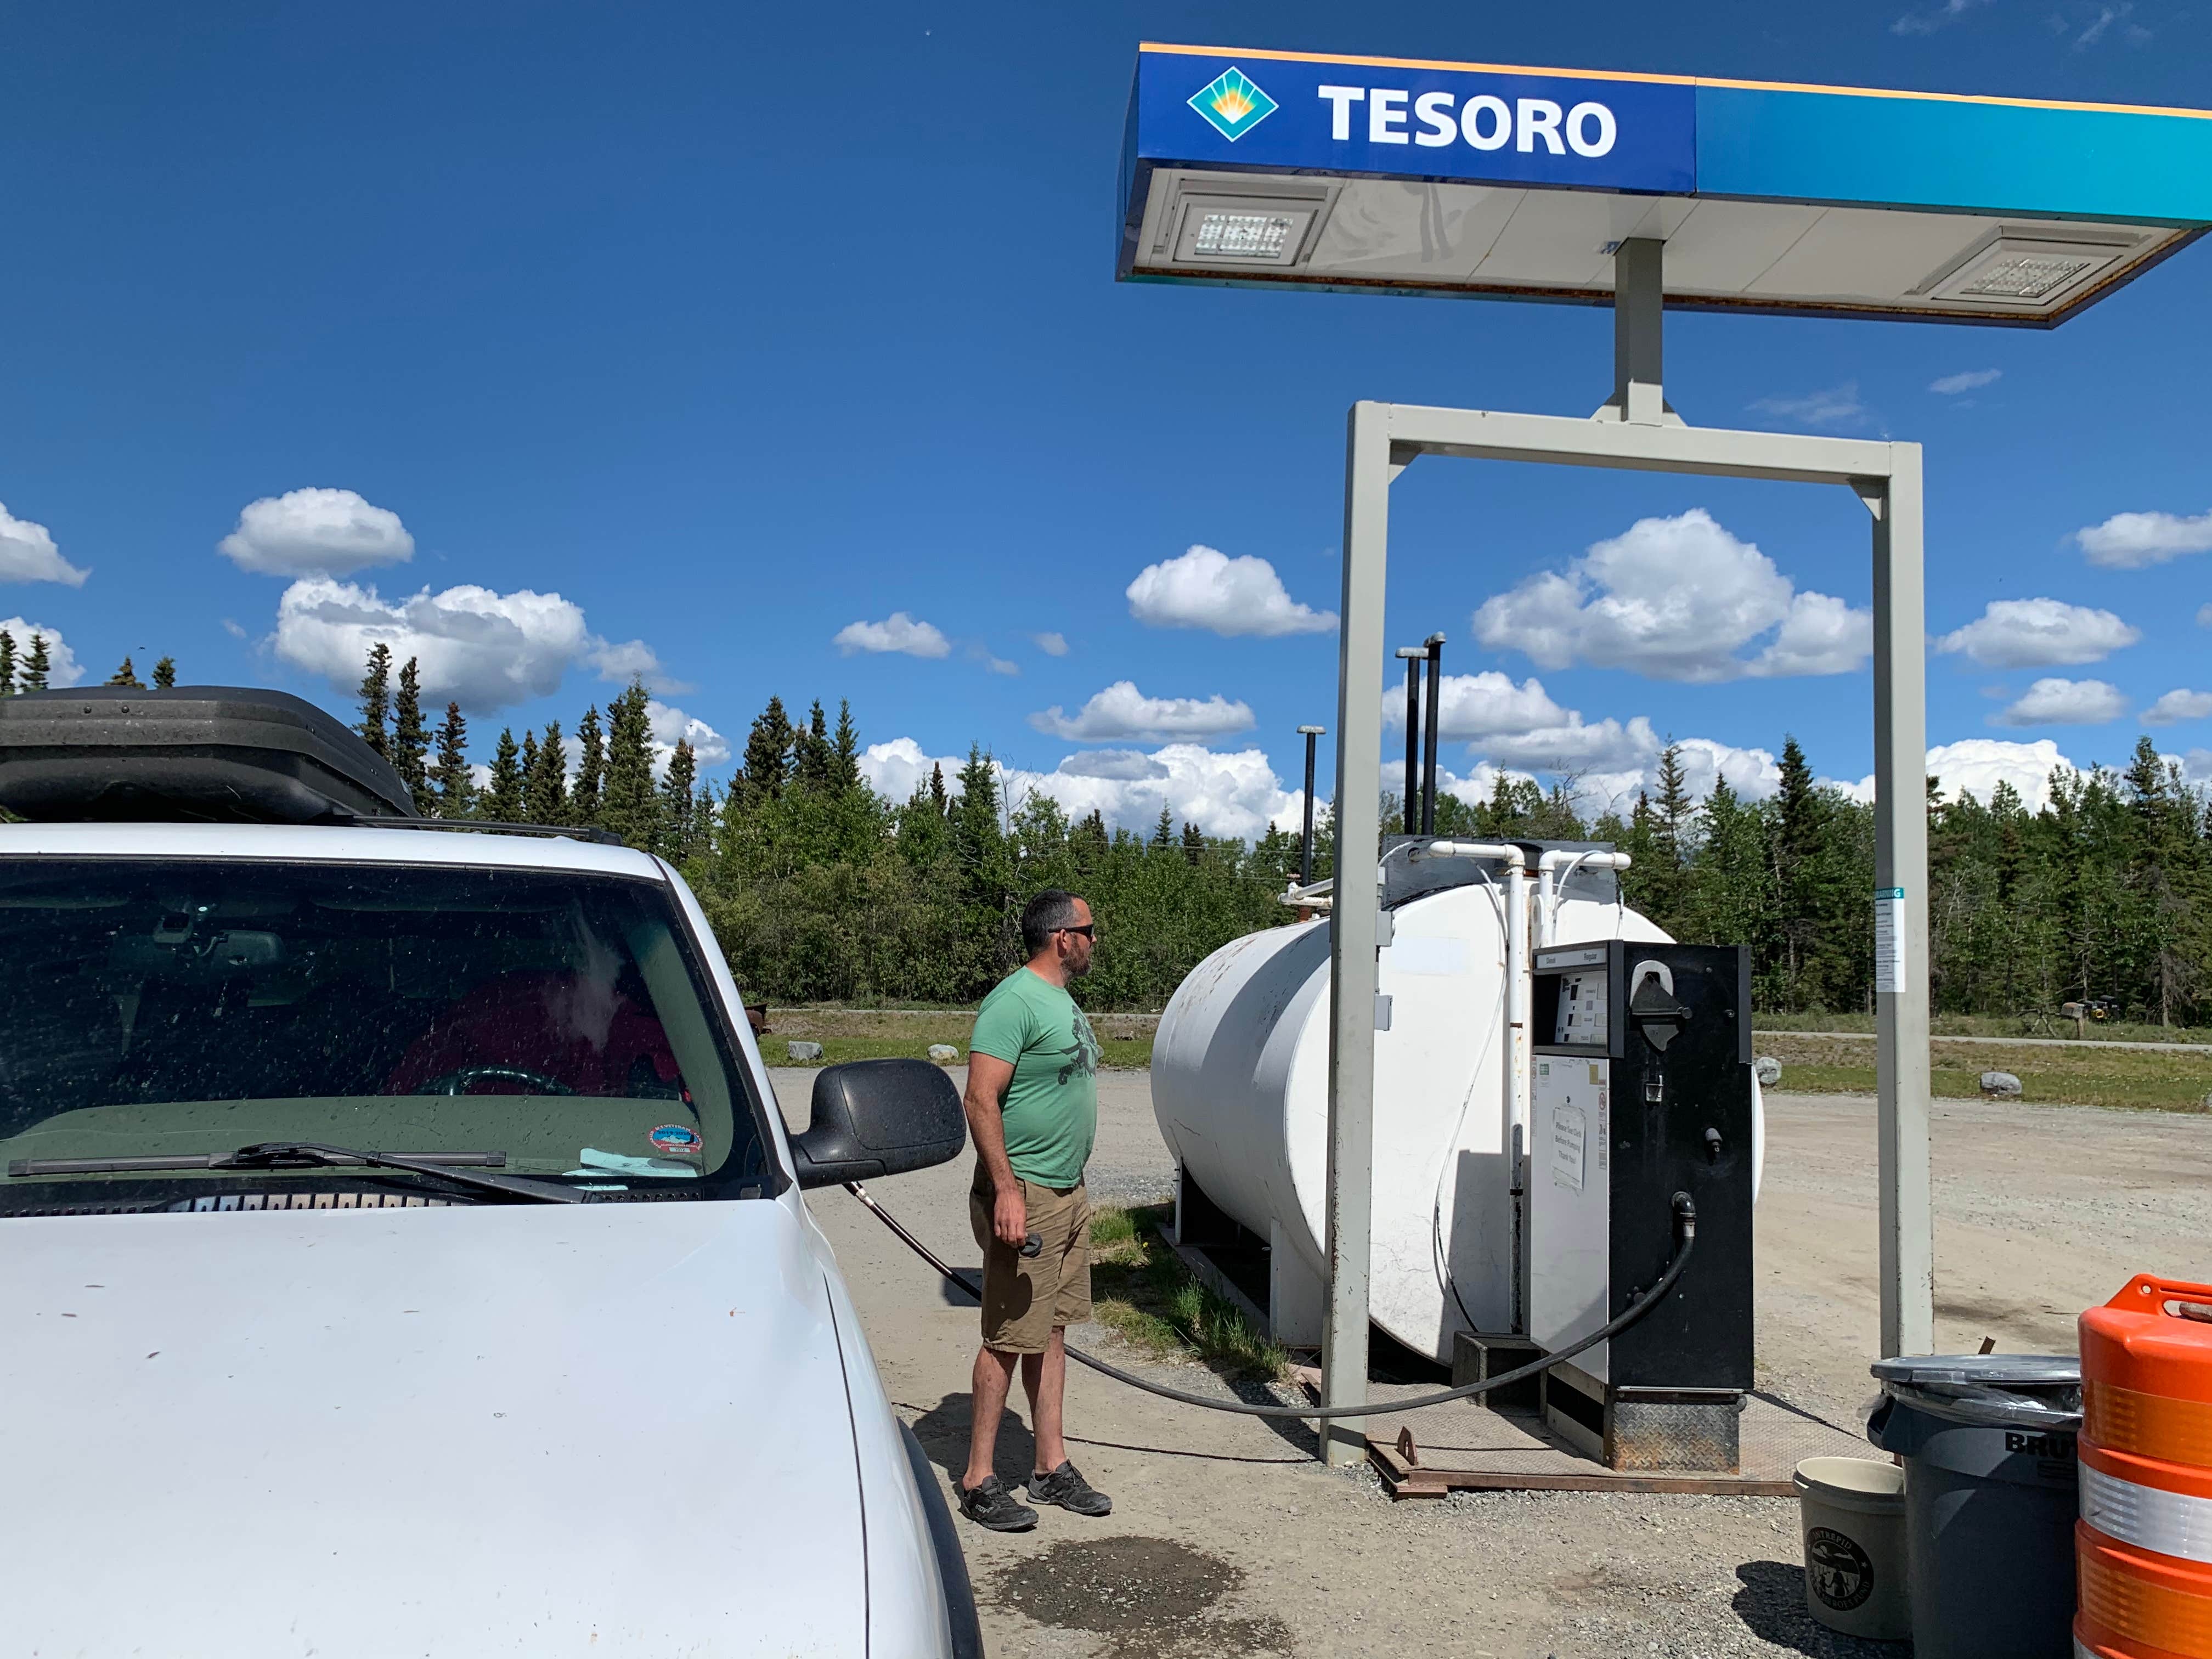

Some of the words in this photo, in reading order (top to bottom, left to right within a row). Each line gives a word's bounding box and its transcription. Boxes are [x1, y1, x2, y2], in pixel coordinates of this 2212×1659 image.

[1317, 84, 1617, 159] TESORO
[1556, 1121, 1567, 1132] Please
[1555, 1135, 1567, 1146] Before
[1567, 1139, 1581, 1153] Pumping
[1558, 1150, 1568, 1160] Thank
[1813, 1530, 1852, 1549] INTREPID
